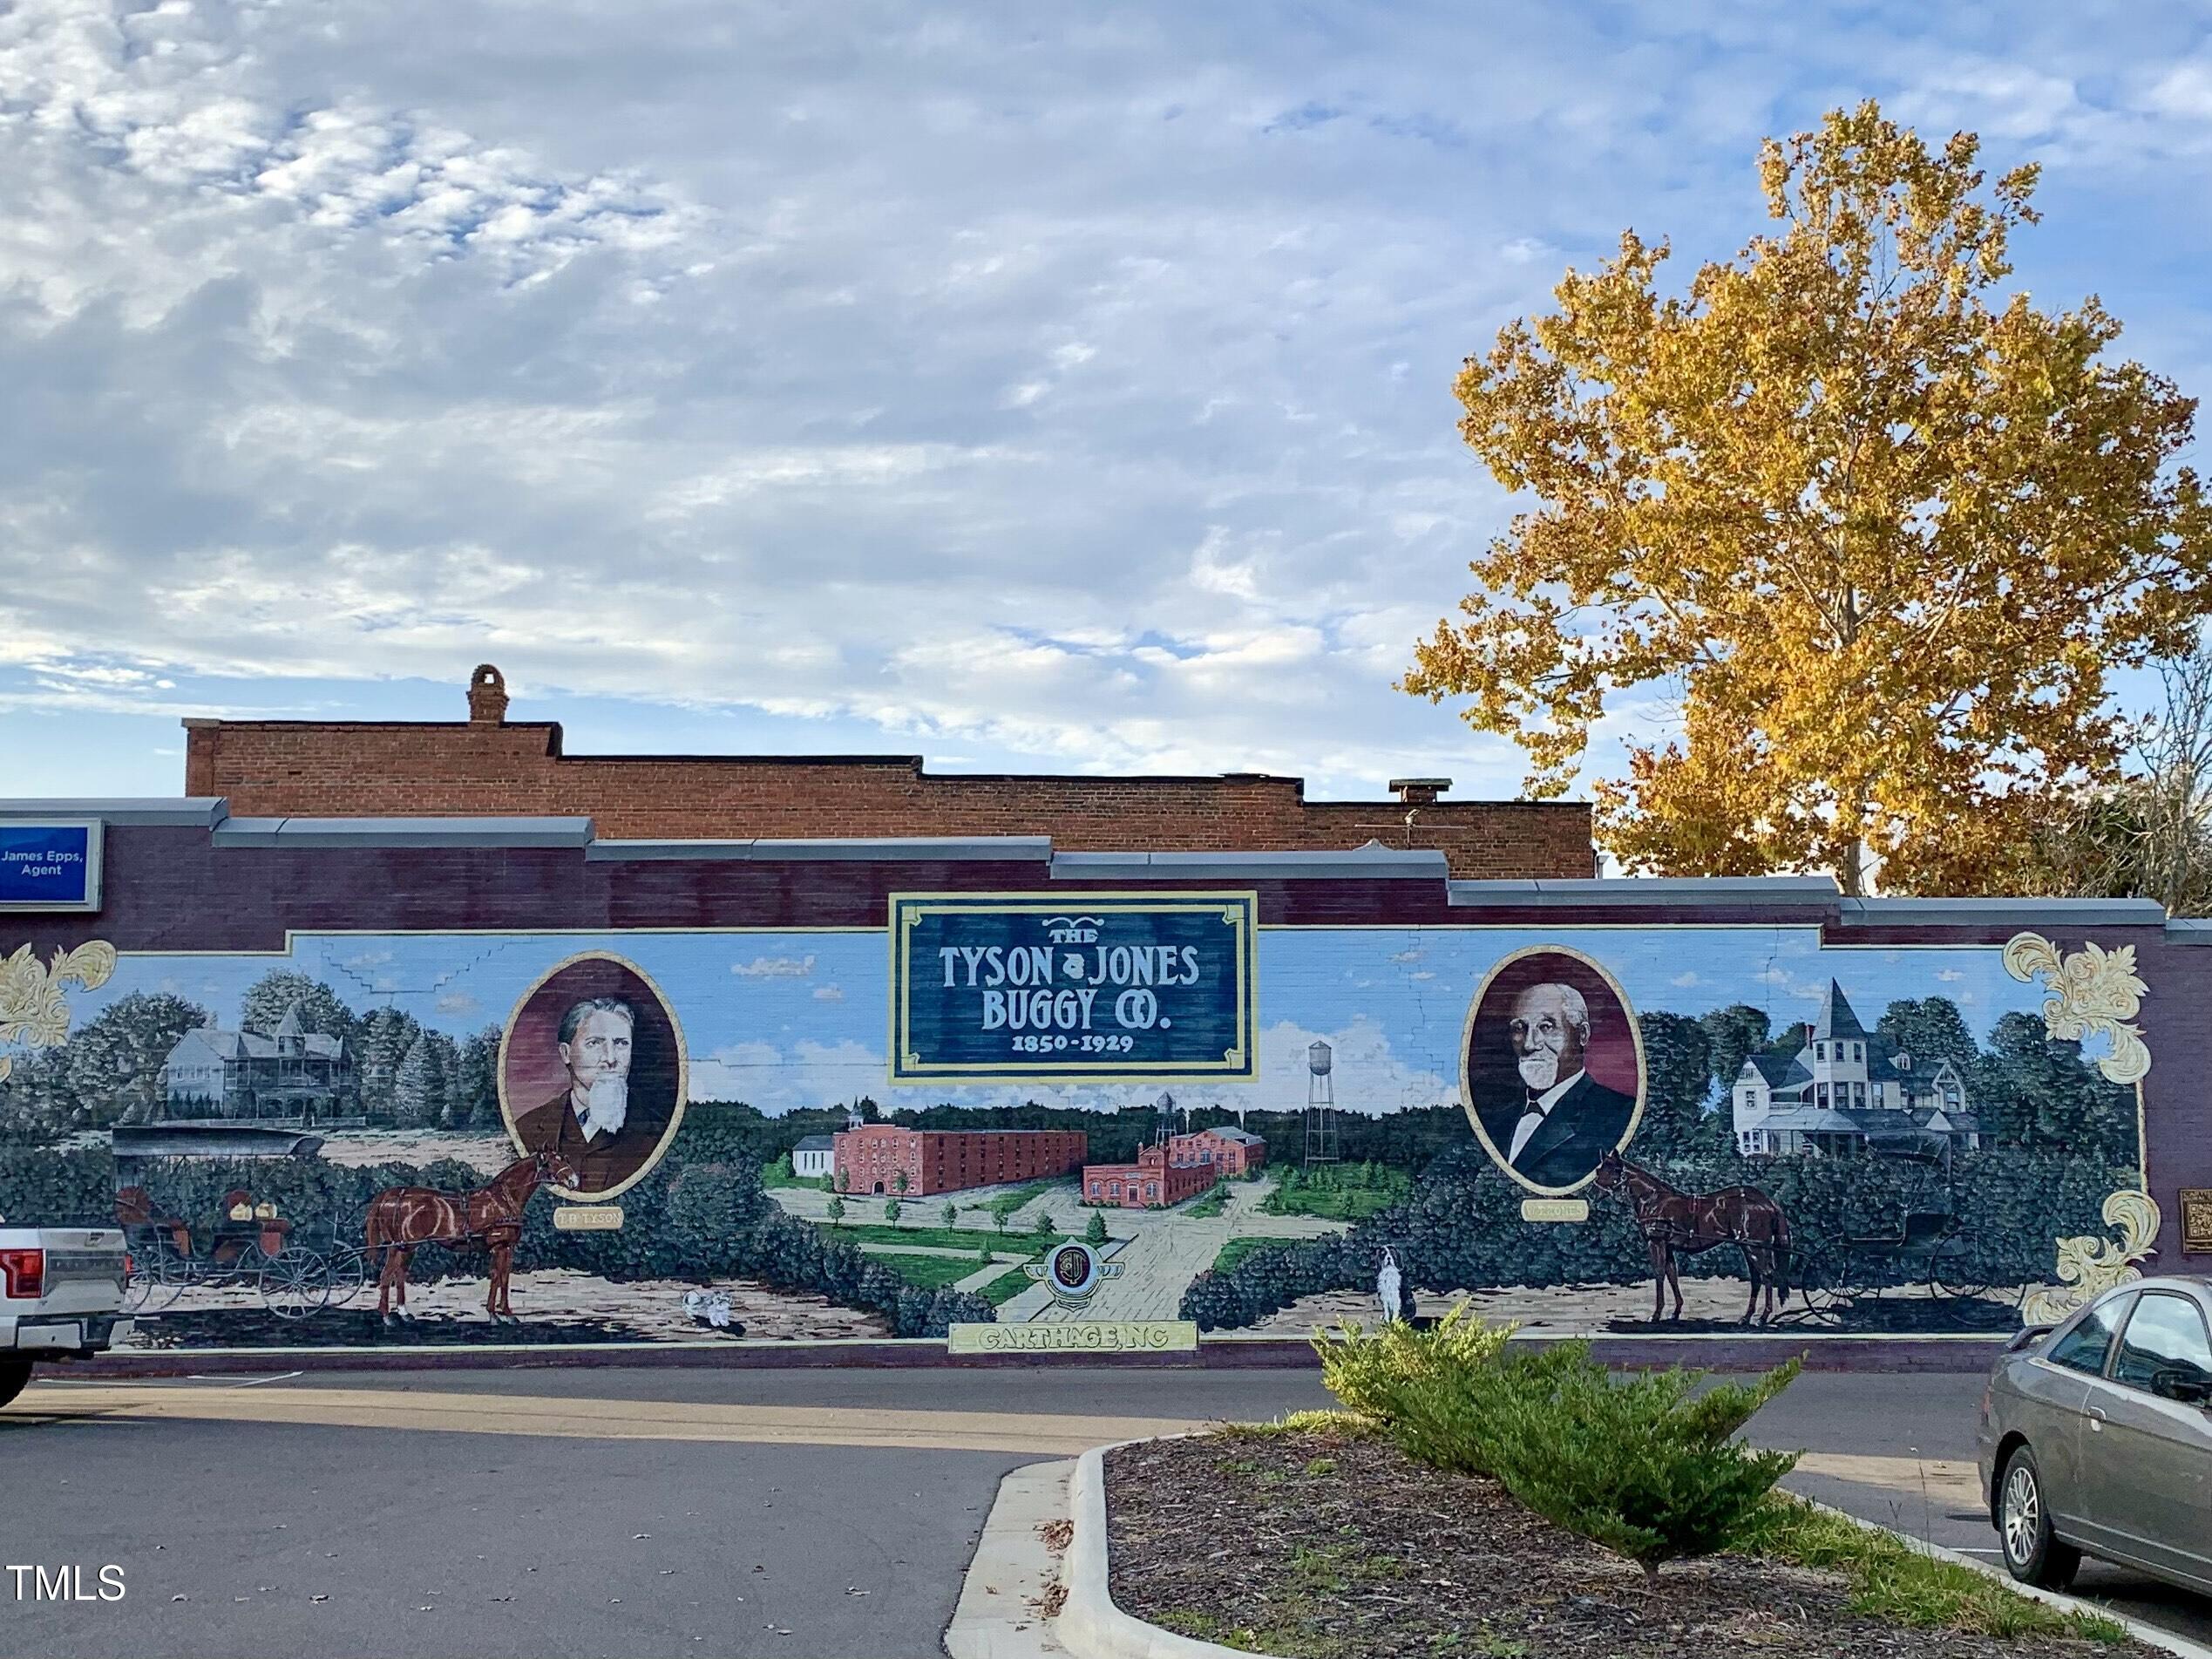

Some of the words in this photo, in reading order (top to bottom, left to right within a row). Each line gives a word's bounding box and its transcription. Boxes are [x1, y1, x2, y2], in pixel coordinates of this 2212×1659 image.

[1, 850, 44, 861] James
[46, 850, 84, 863] Epps,
[21, 864, 62, 877] Agent
[1048, 928, 1099, 944] THE
[939, 946, 1054, 988] TYSON
[1088, 945, 1200, 986] JONES
[981, 989, 1098, 1030] BUGGY
[1115, 988, 1171, 1030] CO.
[1012, 1035, 1134, 1053] 1850-1929
[582, 1213, 621, 1224] TYSON
